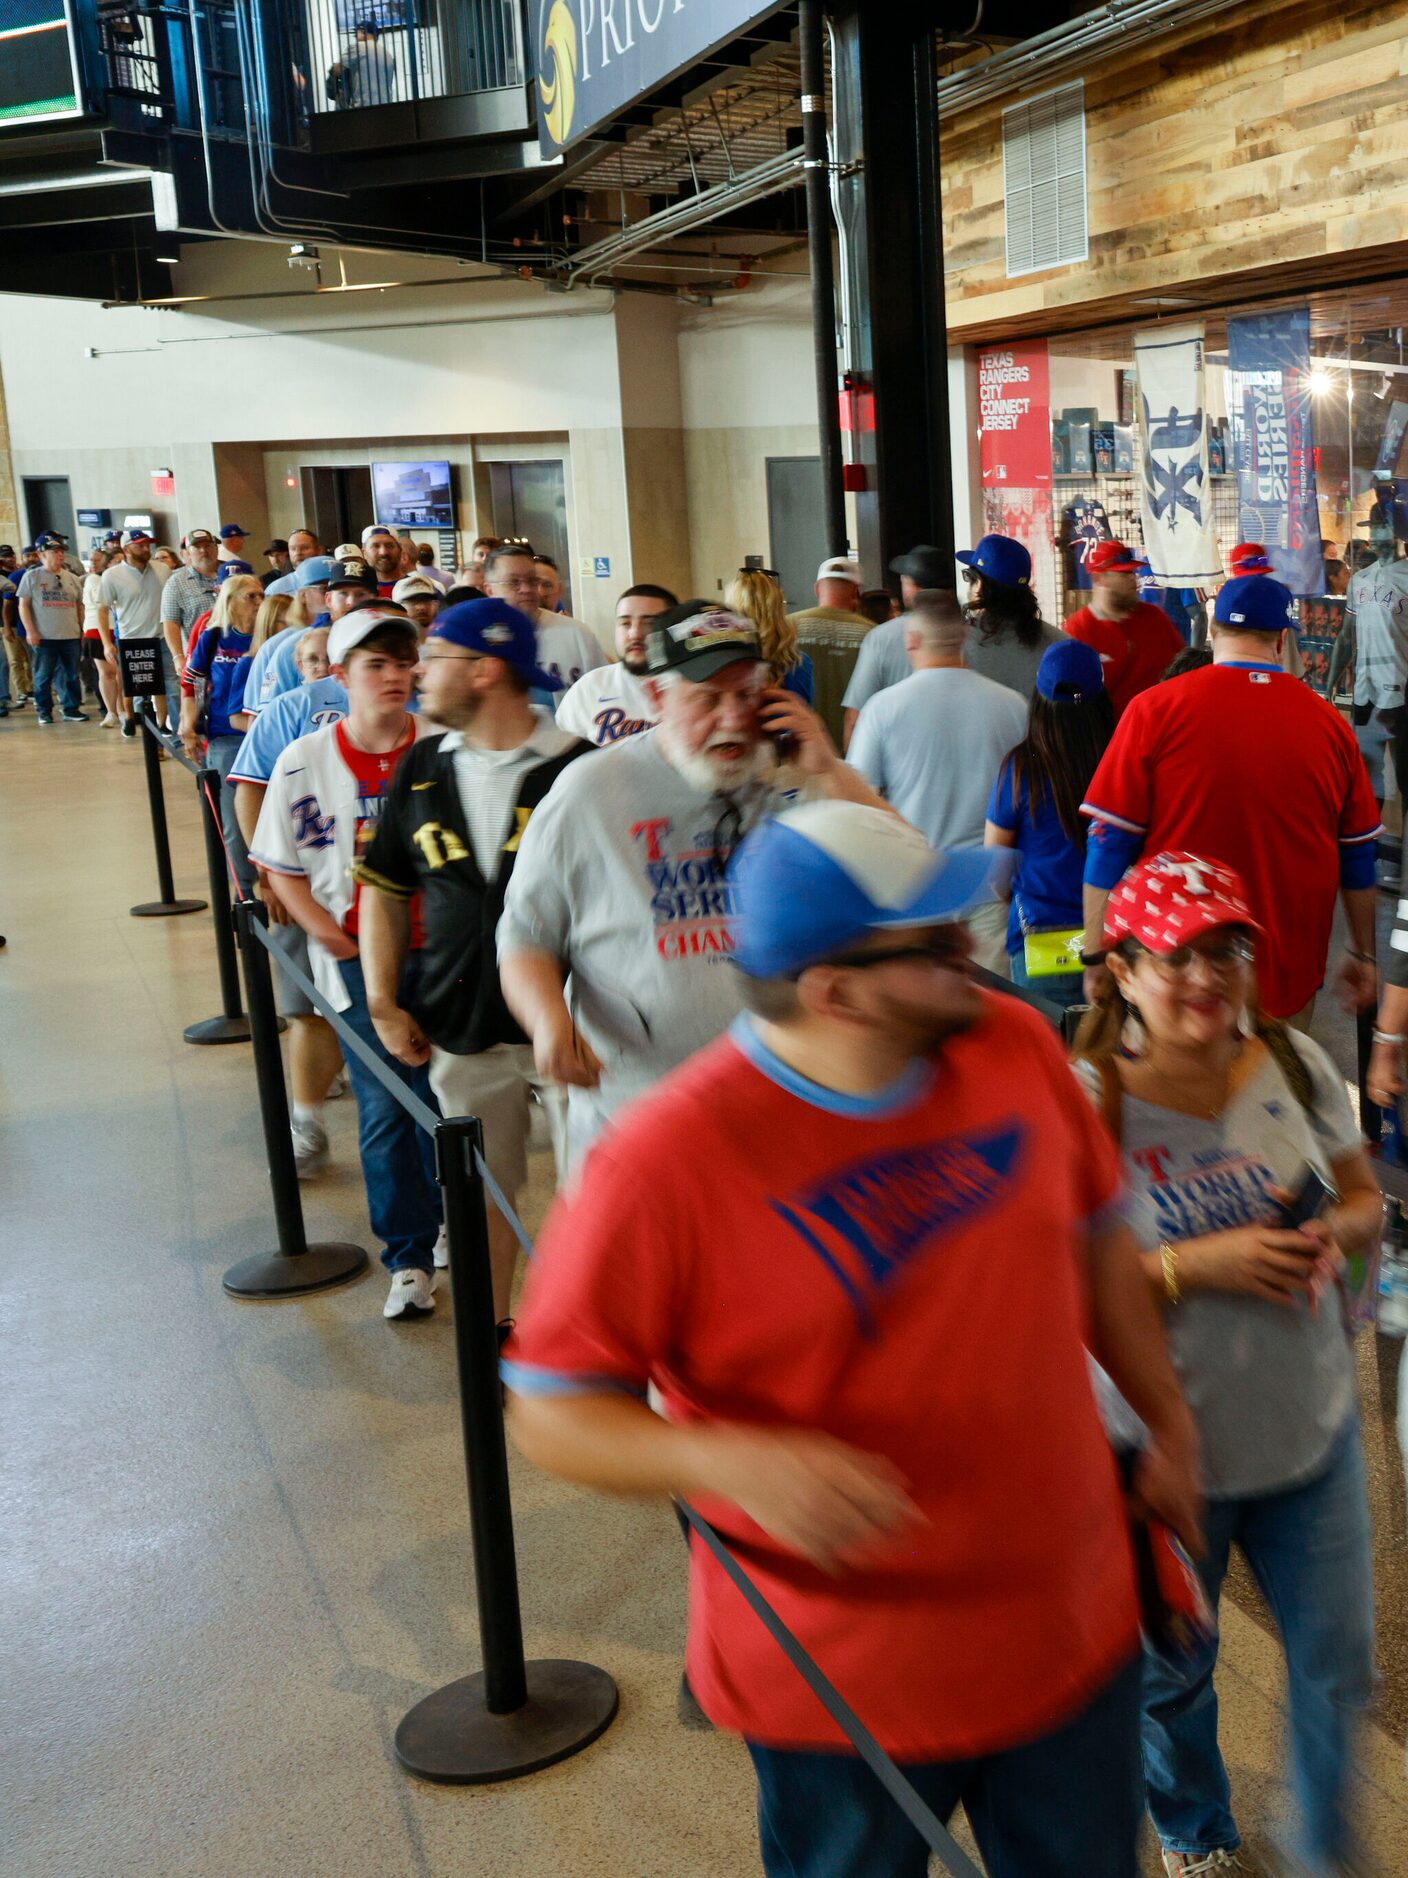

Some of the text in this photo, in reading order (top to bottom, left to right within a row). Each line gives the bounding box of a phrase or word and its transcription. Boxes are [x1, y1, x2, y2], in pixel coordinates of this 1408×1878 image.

[979, 352, 1014, 369] TEXAS
[980, 366, 1030, 385] RANGERS
[980, 384, 1003, 400] CITY
[980, 398, 1030, 415] CONNECT
[981, 415, 1018, 431] JERSEY
[125, 649, 155, 659] PLEASE
[129, 661, 154, 671] ENTER
[132, 673, 154, 683] HERE
